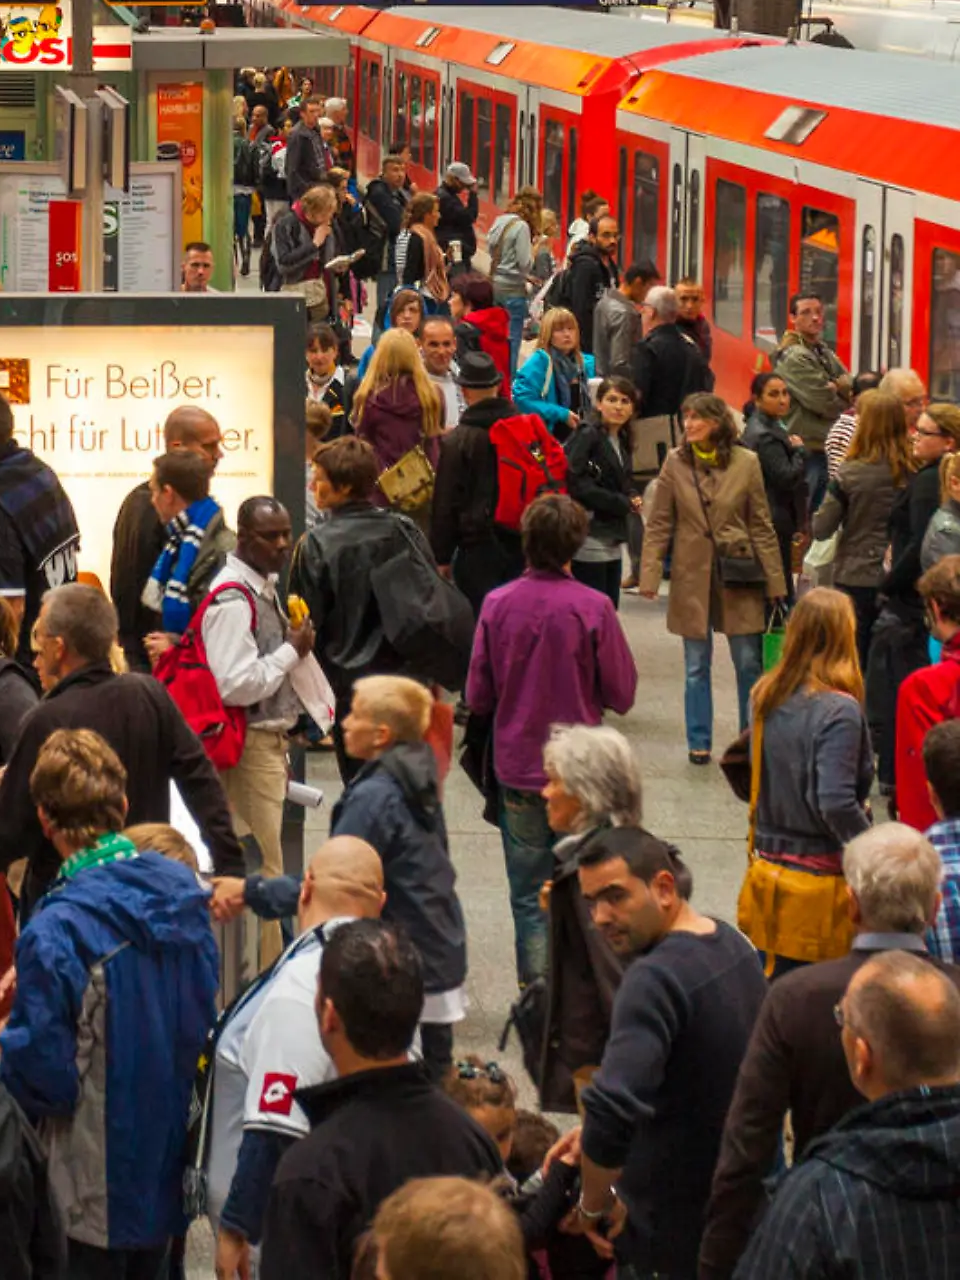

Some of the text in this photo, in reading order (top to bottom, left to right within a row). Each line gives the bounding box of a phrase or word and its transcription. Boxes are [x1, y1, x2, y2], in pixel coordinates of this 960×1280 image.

[56, 252, 78, 263] SOS
[45, 359, 221, 400] Für Beißer.
[14, 414, 259, 452] cht für Luter.
